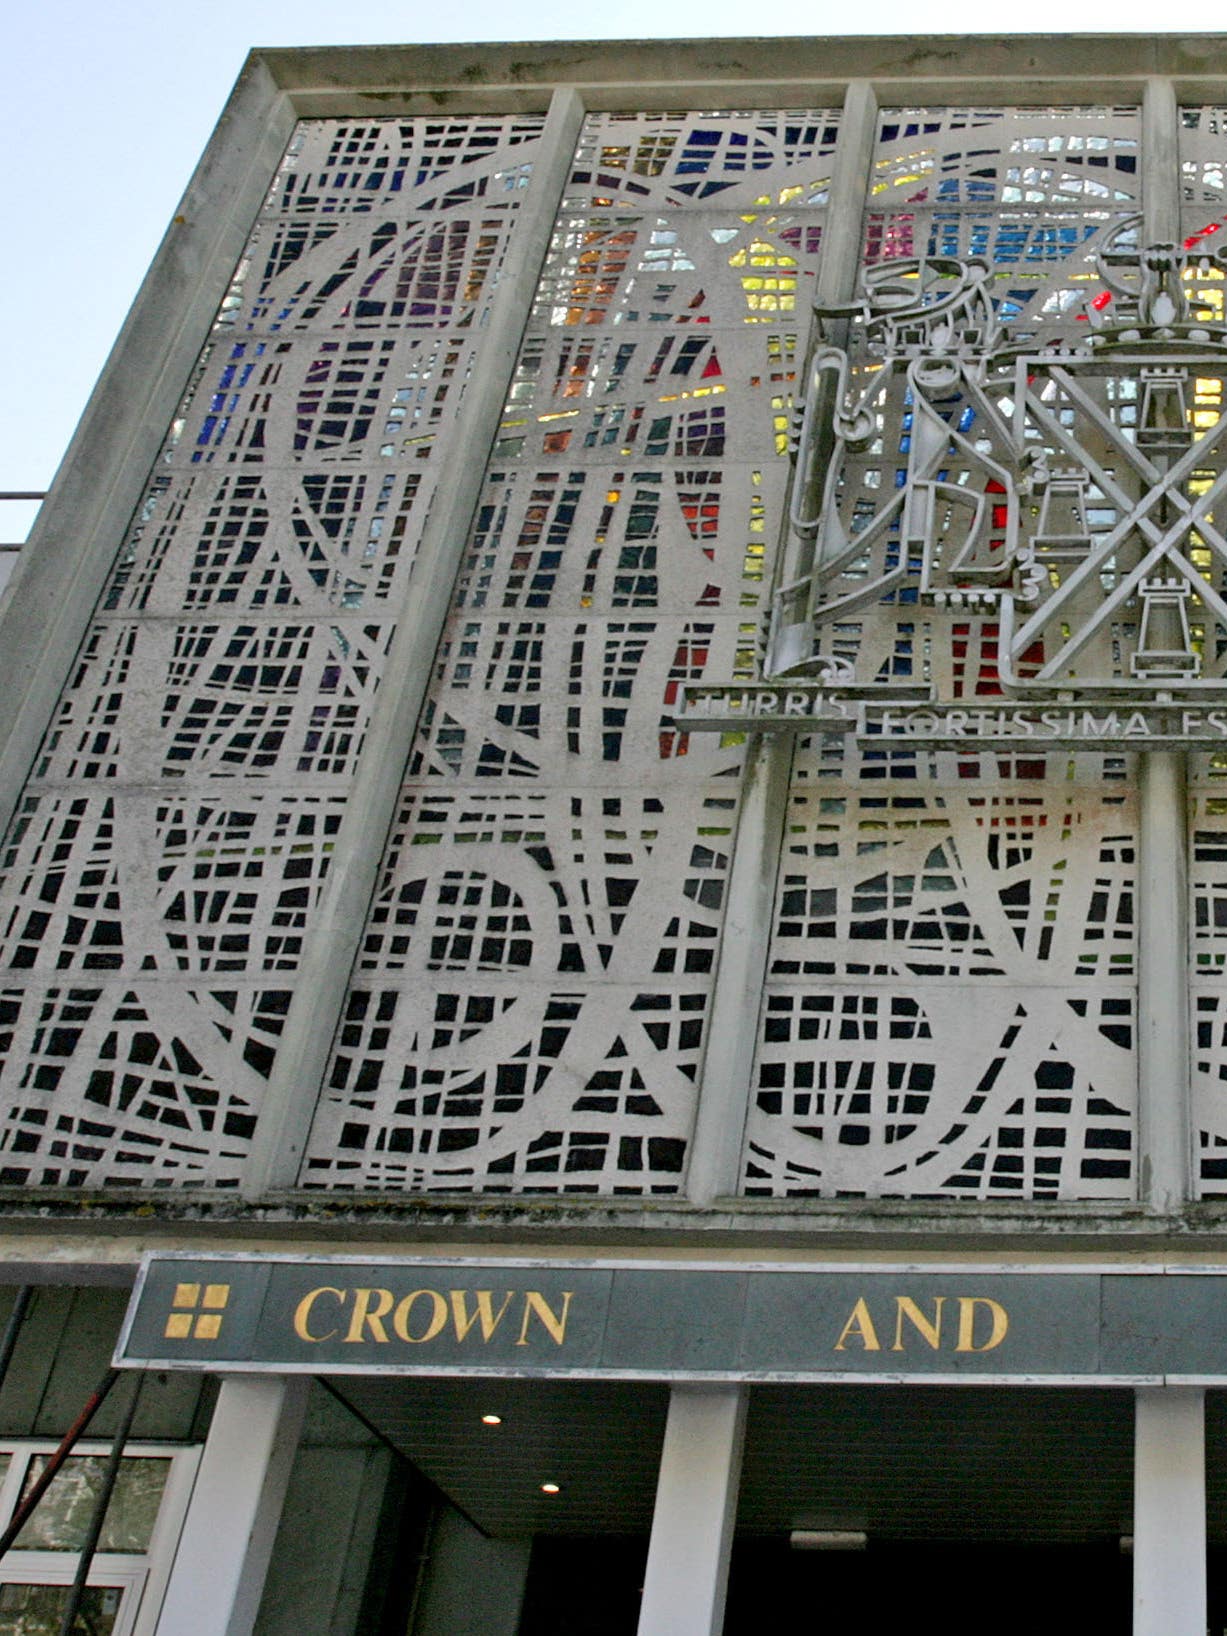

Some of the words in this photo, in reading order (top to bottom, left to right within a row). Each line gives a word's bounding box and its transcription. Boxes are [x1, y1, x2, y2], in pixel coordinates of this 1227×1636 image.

[697, 690, 848, 717] TURRIS
[881, 709, 1151, 736] FORTISSIMA
[293, 1286, 574, 1346] CROWN
[835, 1295, 1009, 1352] AND
